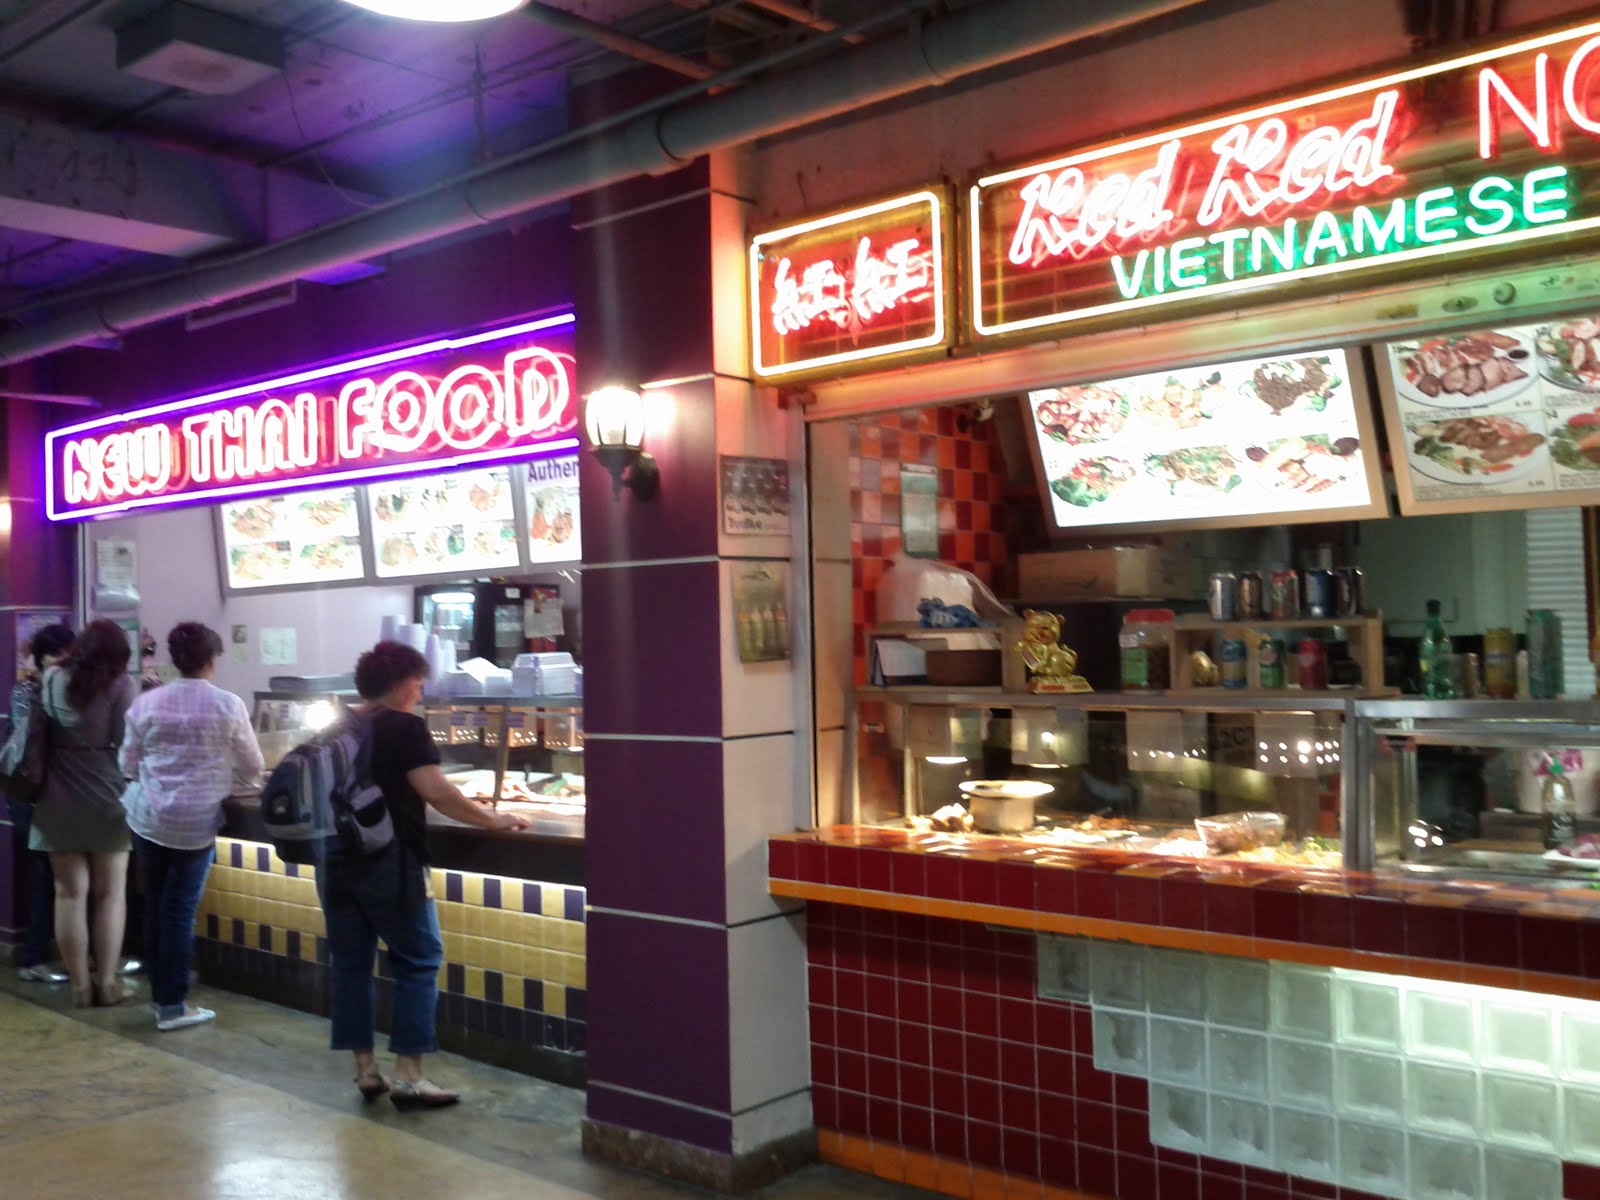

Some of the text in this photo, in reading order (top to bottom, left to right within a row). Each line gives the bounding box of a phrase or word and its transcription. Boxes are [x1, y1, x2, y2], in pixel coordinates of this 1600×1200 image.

[1009, 139, 1181, 265] Red
[1197, 89, 1400, 226] Red
[1111, 165, 1568, 299] VIETNAMESE
[63, 346, 570, 504] NEW THAI FOOD
